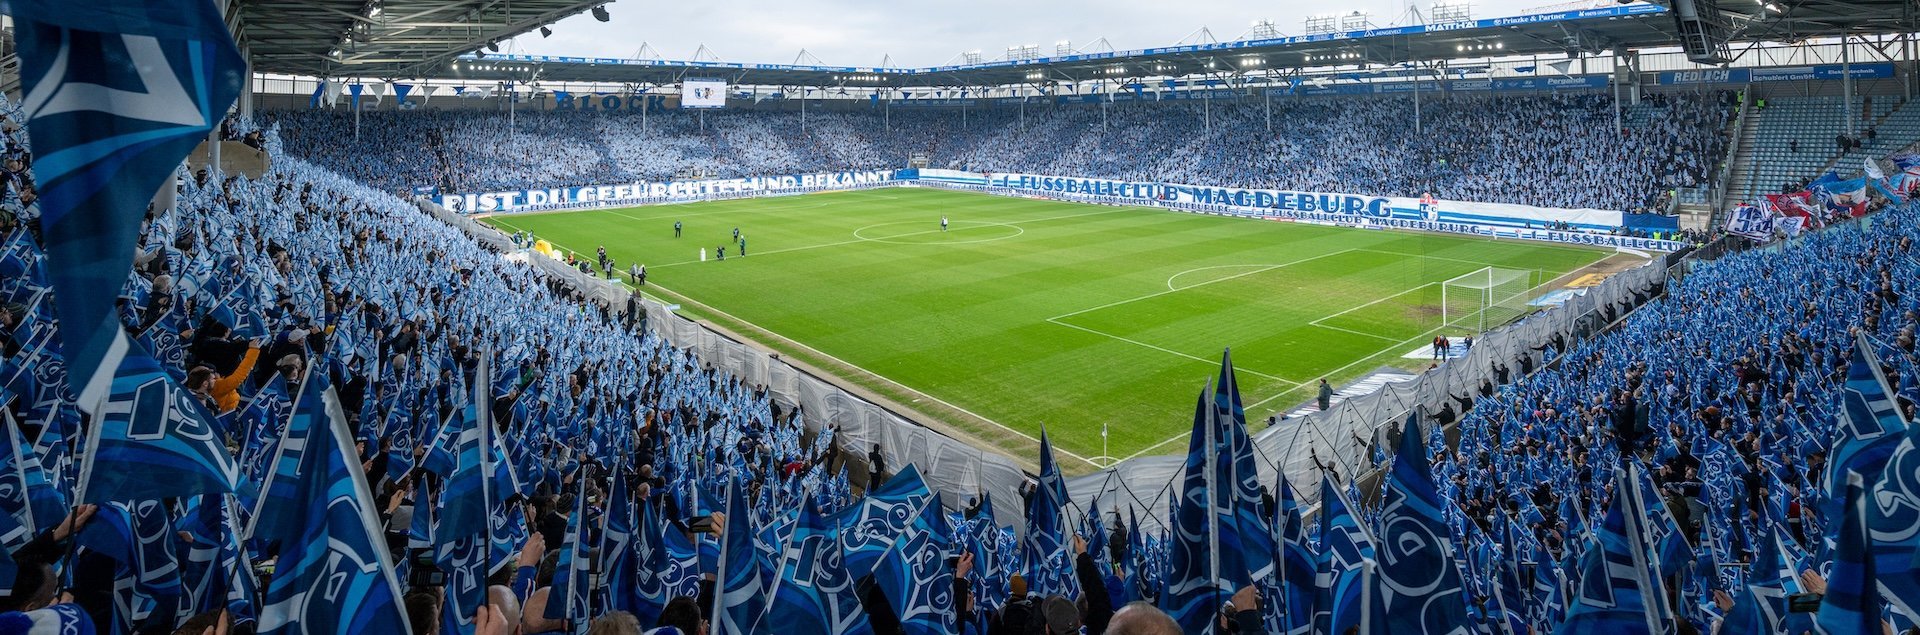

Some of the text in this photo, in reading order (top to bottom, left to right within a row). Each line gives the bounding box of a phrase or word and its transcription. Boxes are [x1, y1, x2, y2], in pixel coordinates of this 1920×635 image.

[1502, 15, 1536, 25] Prinzke
[1549, 10, 1577, 20] Partner
[1376, 28, 1402, 36] AENGEVELT
[1425, 20, 1478, 32] MATTHÄI
[1547, 77, 1586, 87] Pergande
[1673, 70, 1731, 82] REDLICH
[1753, 74, 1788, 82] Schubert
[558, 95, 666, 111] BLOCK
[443, 191, 522, 213] BIST
[576, 178, 749, 202] GEFÜRCHTET
[754, 176, 799, 191] UND
[802, 169, 894, 188] BEKANNT
[1020, 176, 1179, 201] FUSSBALLCLUB
[1193, 188, 1392, 218] MAGDEBURG
[1273, 209, 1363, 224] FUSSBALLCLUB
